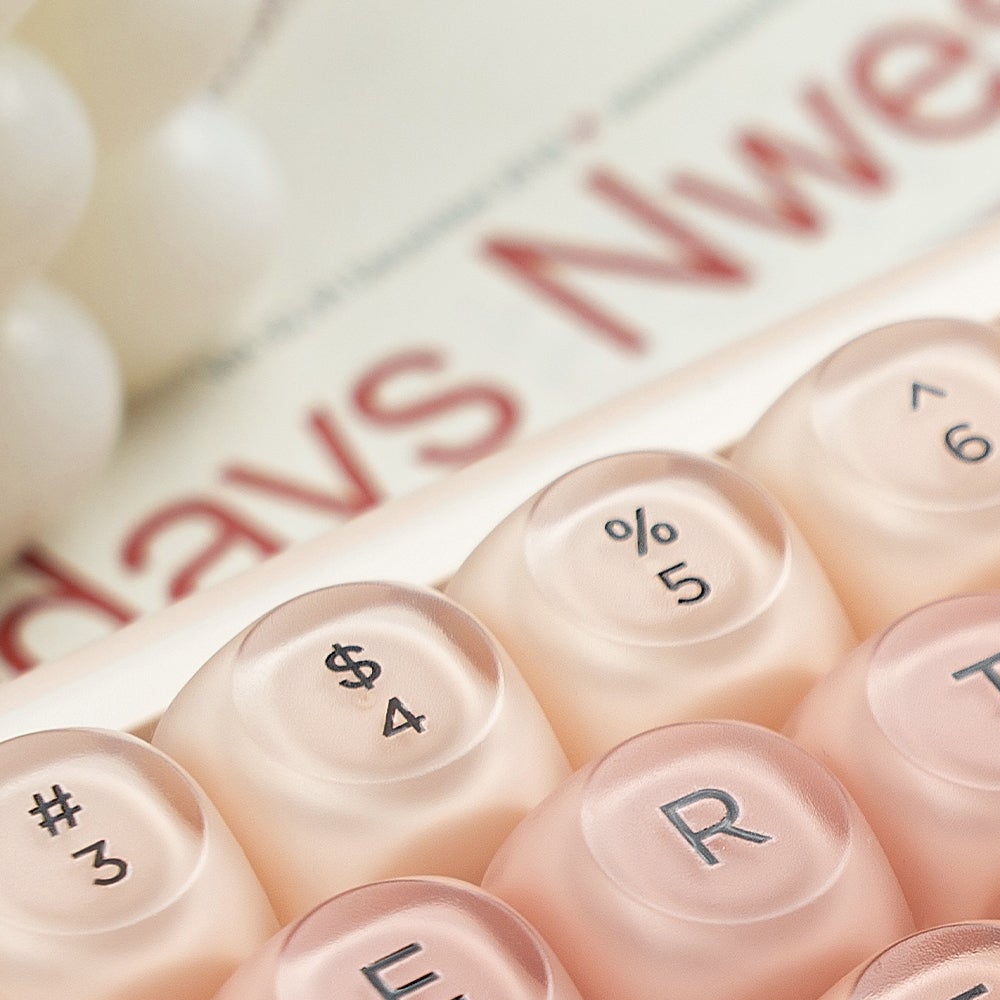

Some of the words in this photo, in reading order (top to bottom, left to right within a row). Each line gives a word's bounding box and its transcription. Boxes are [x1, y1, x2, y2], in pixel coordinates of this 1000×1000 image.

[943, 424, 992, 464] 6
[604, 507, 679, 556] %
[657, 561, 710, 605] 5
[324, 643, 382, 691] $
[382, 696, 426, 738] 4
[28, 784, 82, 837] #
[659, 788, 773, 866] R
[71, 839, 128, 886] 3
